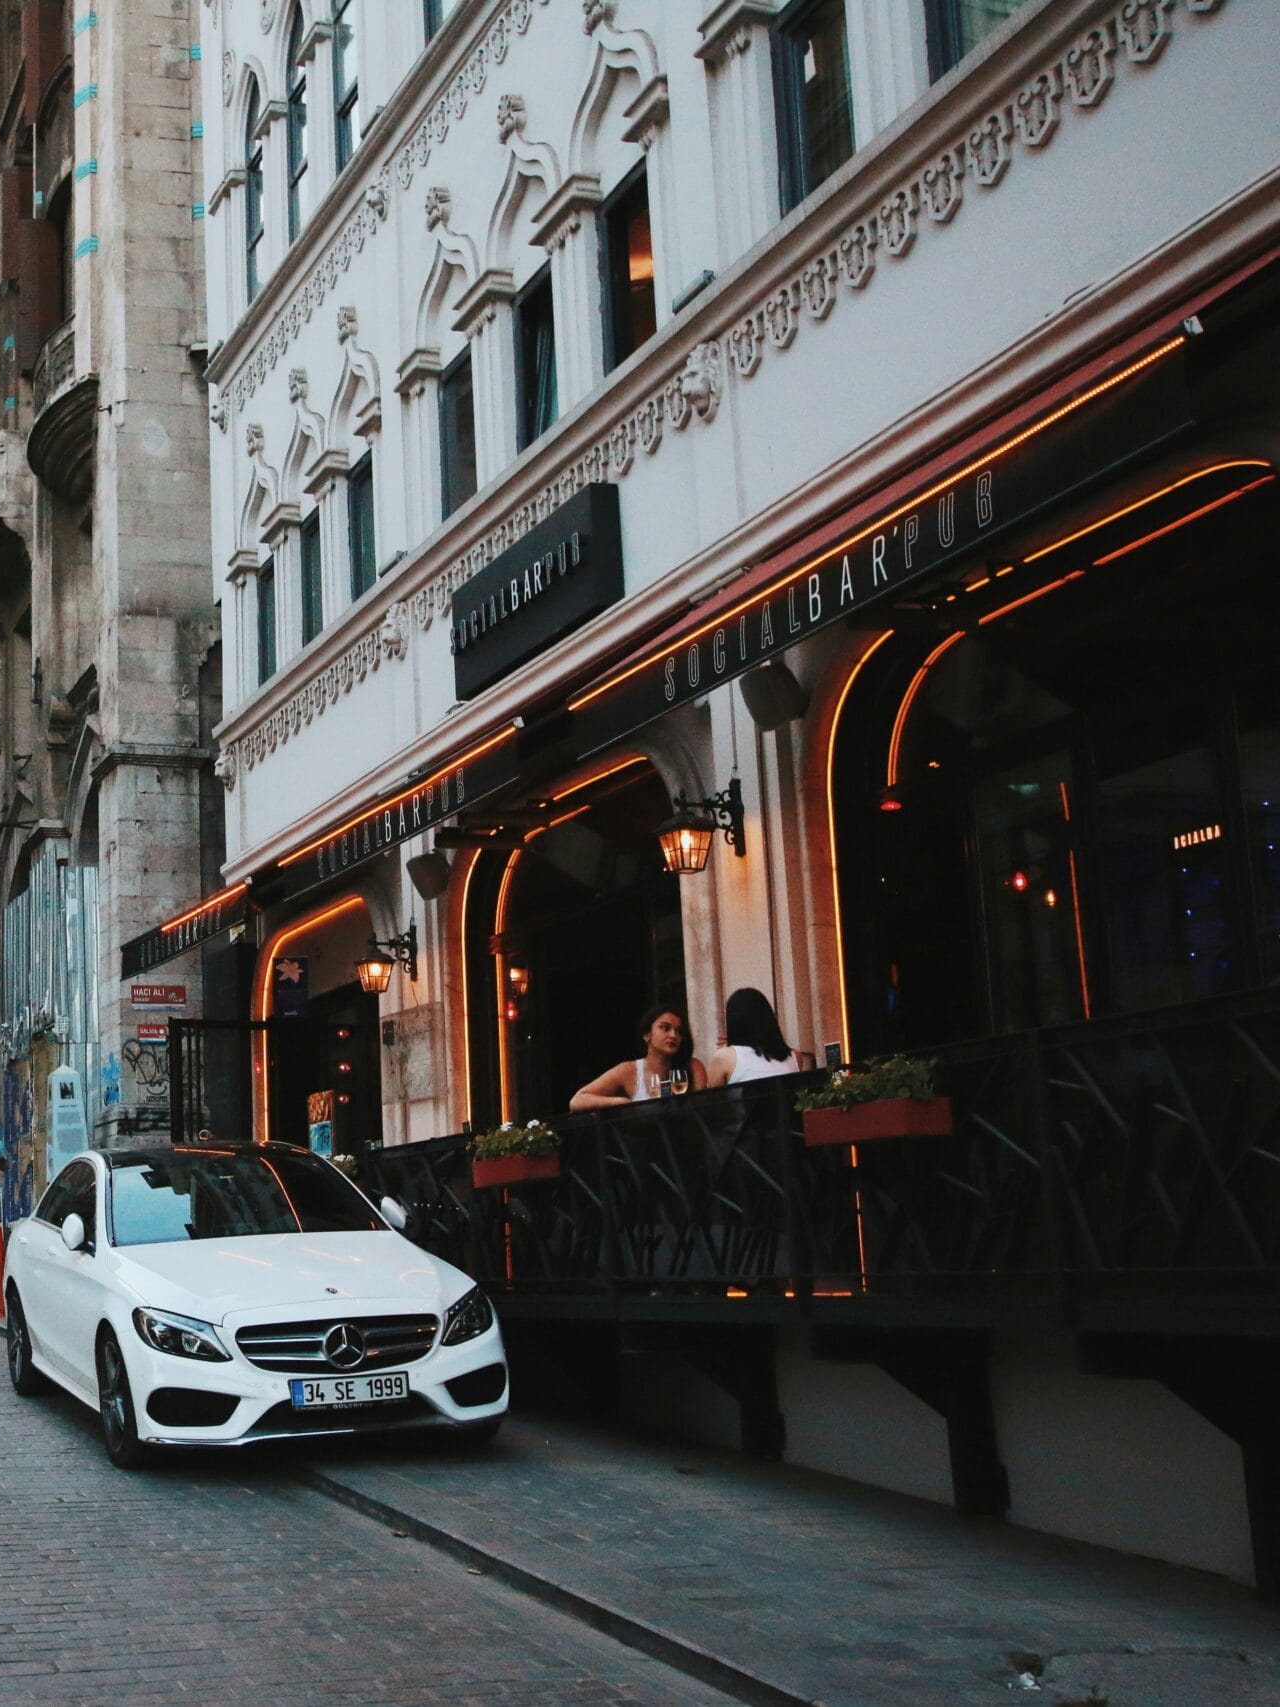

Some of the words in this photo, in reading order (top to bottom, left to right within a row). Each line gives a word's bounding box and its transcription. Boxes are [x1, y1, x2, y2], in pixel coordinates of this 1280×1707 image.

[450, 531, 581, 656] SOCIALBAR'PUB
[664, 470, 993, 701] SOCIALBAR'PUB
[133, 988, 151, 996] HACI
[152, 987, 165, 997] ALİ
[304, 1383, 325, 1402] 34
[335, 1381, 355, 1400] SE
[366, 1377, 403, 1398] 1999
